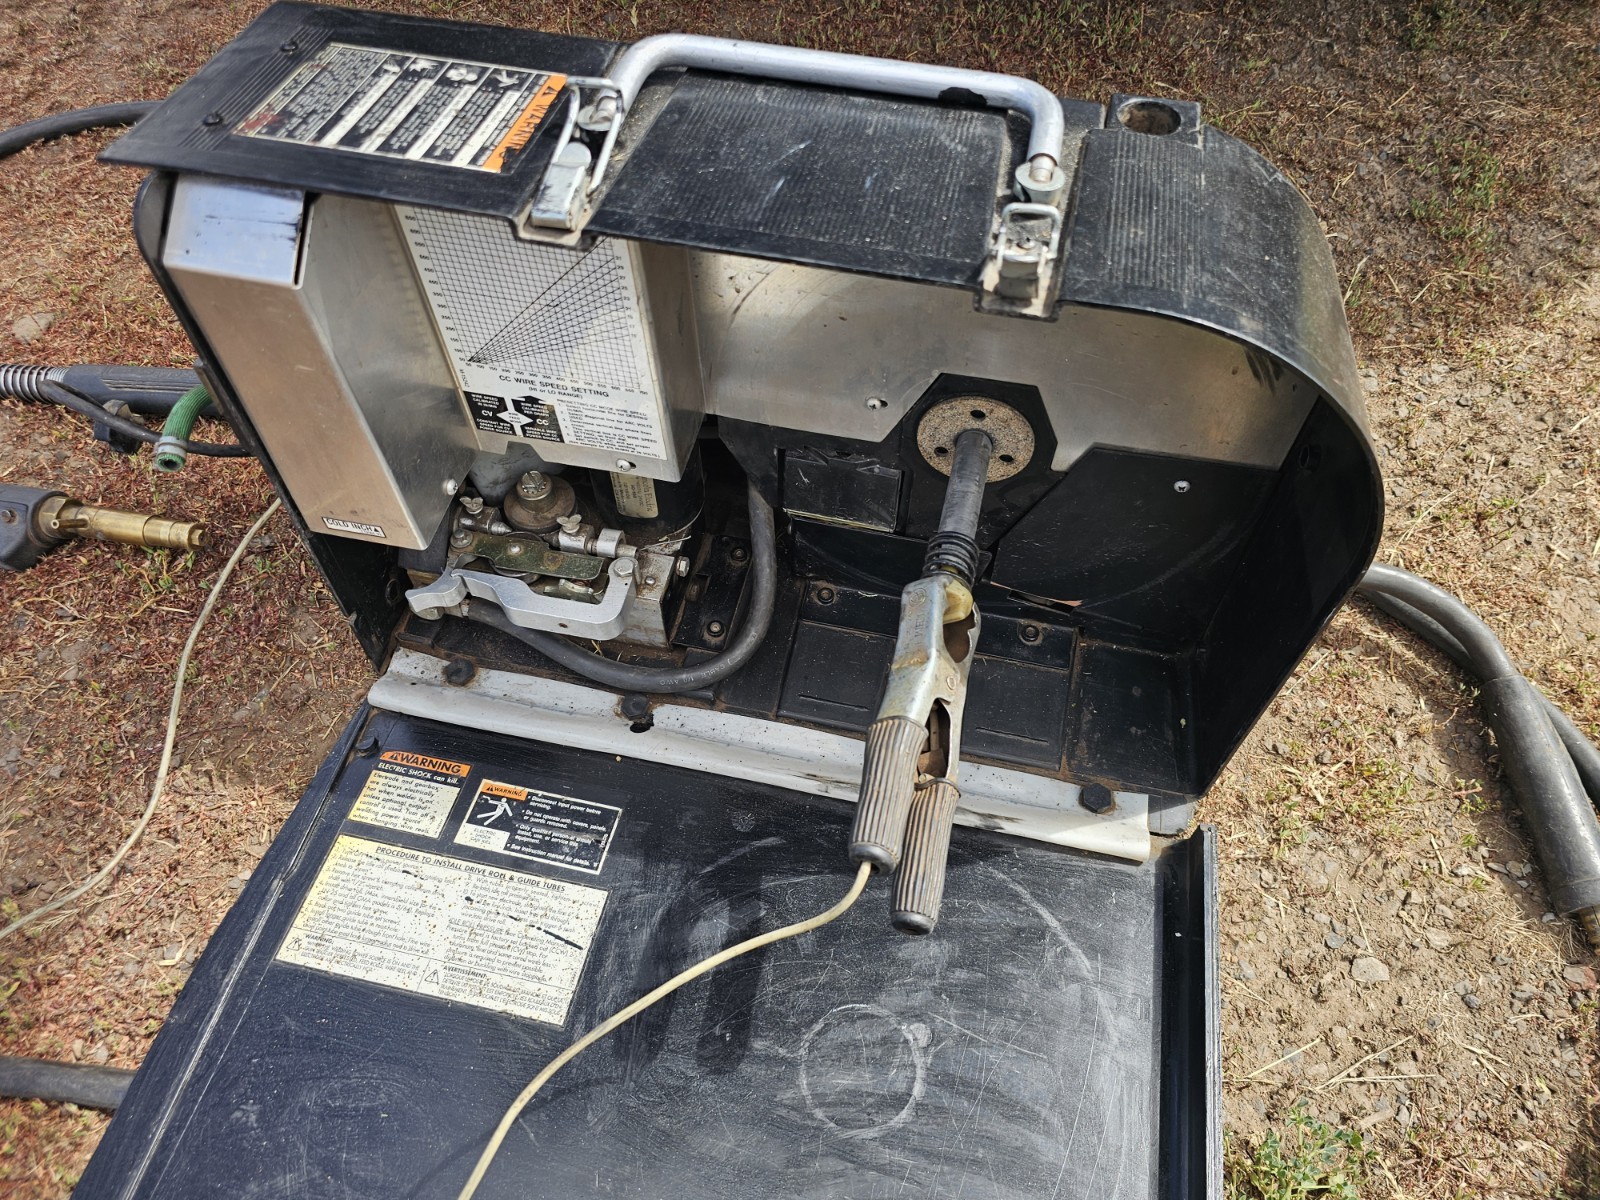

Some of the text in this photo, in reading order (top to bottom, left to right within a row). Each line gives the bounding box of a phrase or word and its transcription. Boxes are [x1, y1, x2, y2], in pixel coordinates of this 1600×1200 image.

[513, 377, 536, 385] WIRE
[539, 381, 568, 390] SPEED
[570, 386, 609, 397] SETTING
[326, 518, 373, 532] COLD INCH
[377, 762, 407, 773] ELECTRIC
[407, 768, 432, 778] SHOCK
[398, 753, 462, 774] WARNING
[373, 772, 400, 782] Electrode
[380, 782, 402, 791] always
[403, 787, 435, 797] electrically
[493, 786, 522, 796] WARNING
[358, 799, 379, 807] control
[530, 796, 557, 805] Disconnect
[355, 805, 379, 815] welding
[380, 812, 400, 820] power
[369, 816, 397, 827] changing
[545, 820, 568, 828] removed.
[374, 846, 420, 861] PROCEDURE
[432, 858, 462, 870] INSTALL
[463, 864, 487, 875] DRIVE
[516, 876, 541, 886] GUIDE
[542, 881, 566, 892] TUBES
